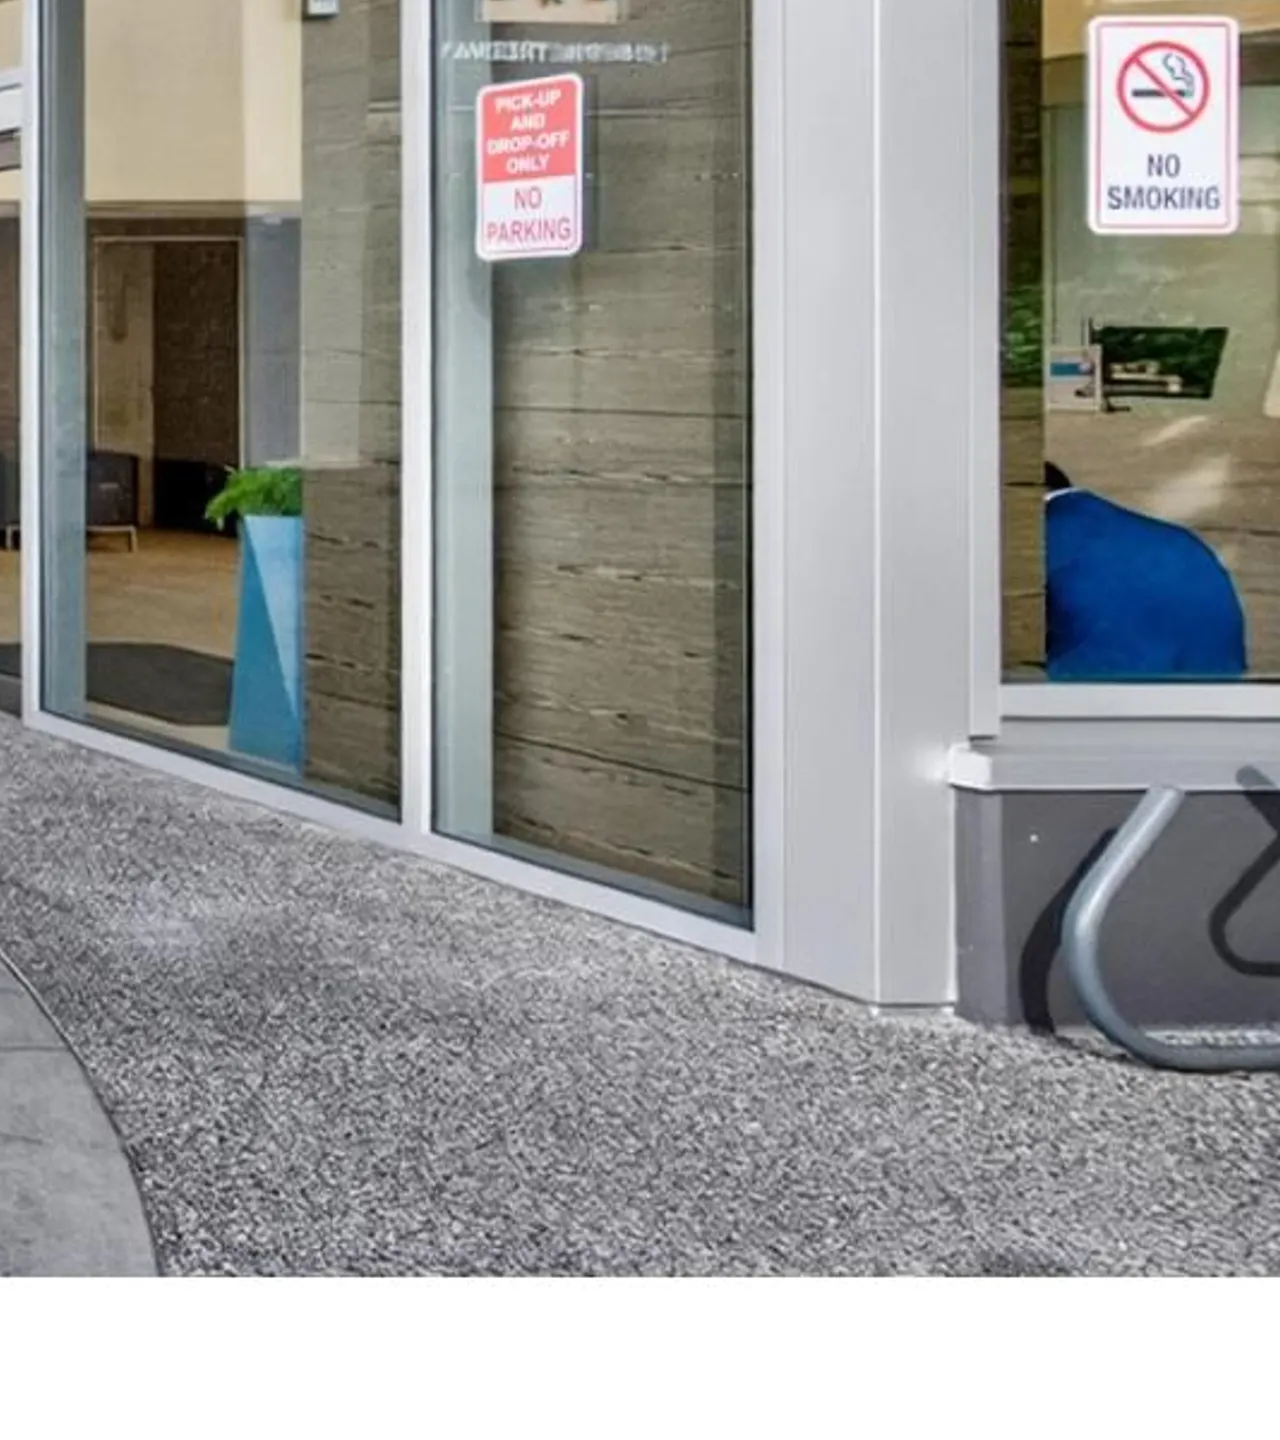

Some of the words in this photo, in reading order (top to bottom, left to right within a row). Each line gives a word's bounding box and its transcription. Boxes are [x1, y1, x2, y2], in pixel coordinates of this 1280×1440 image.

[493, 89, 562, 111] PICK-UP
[511, 113, 546, 131] AND
[487, 131, 570, 155] DROP-OFF
[507, 154, 550, 173] ONLY
[1147, 154, 1181, 179] NO
[514, 186, 542, 210] NO
[1107, 186, 1222, 212] SMOKING
[486, 216, 572, 244] PARKING
